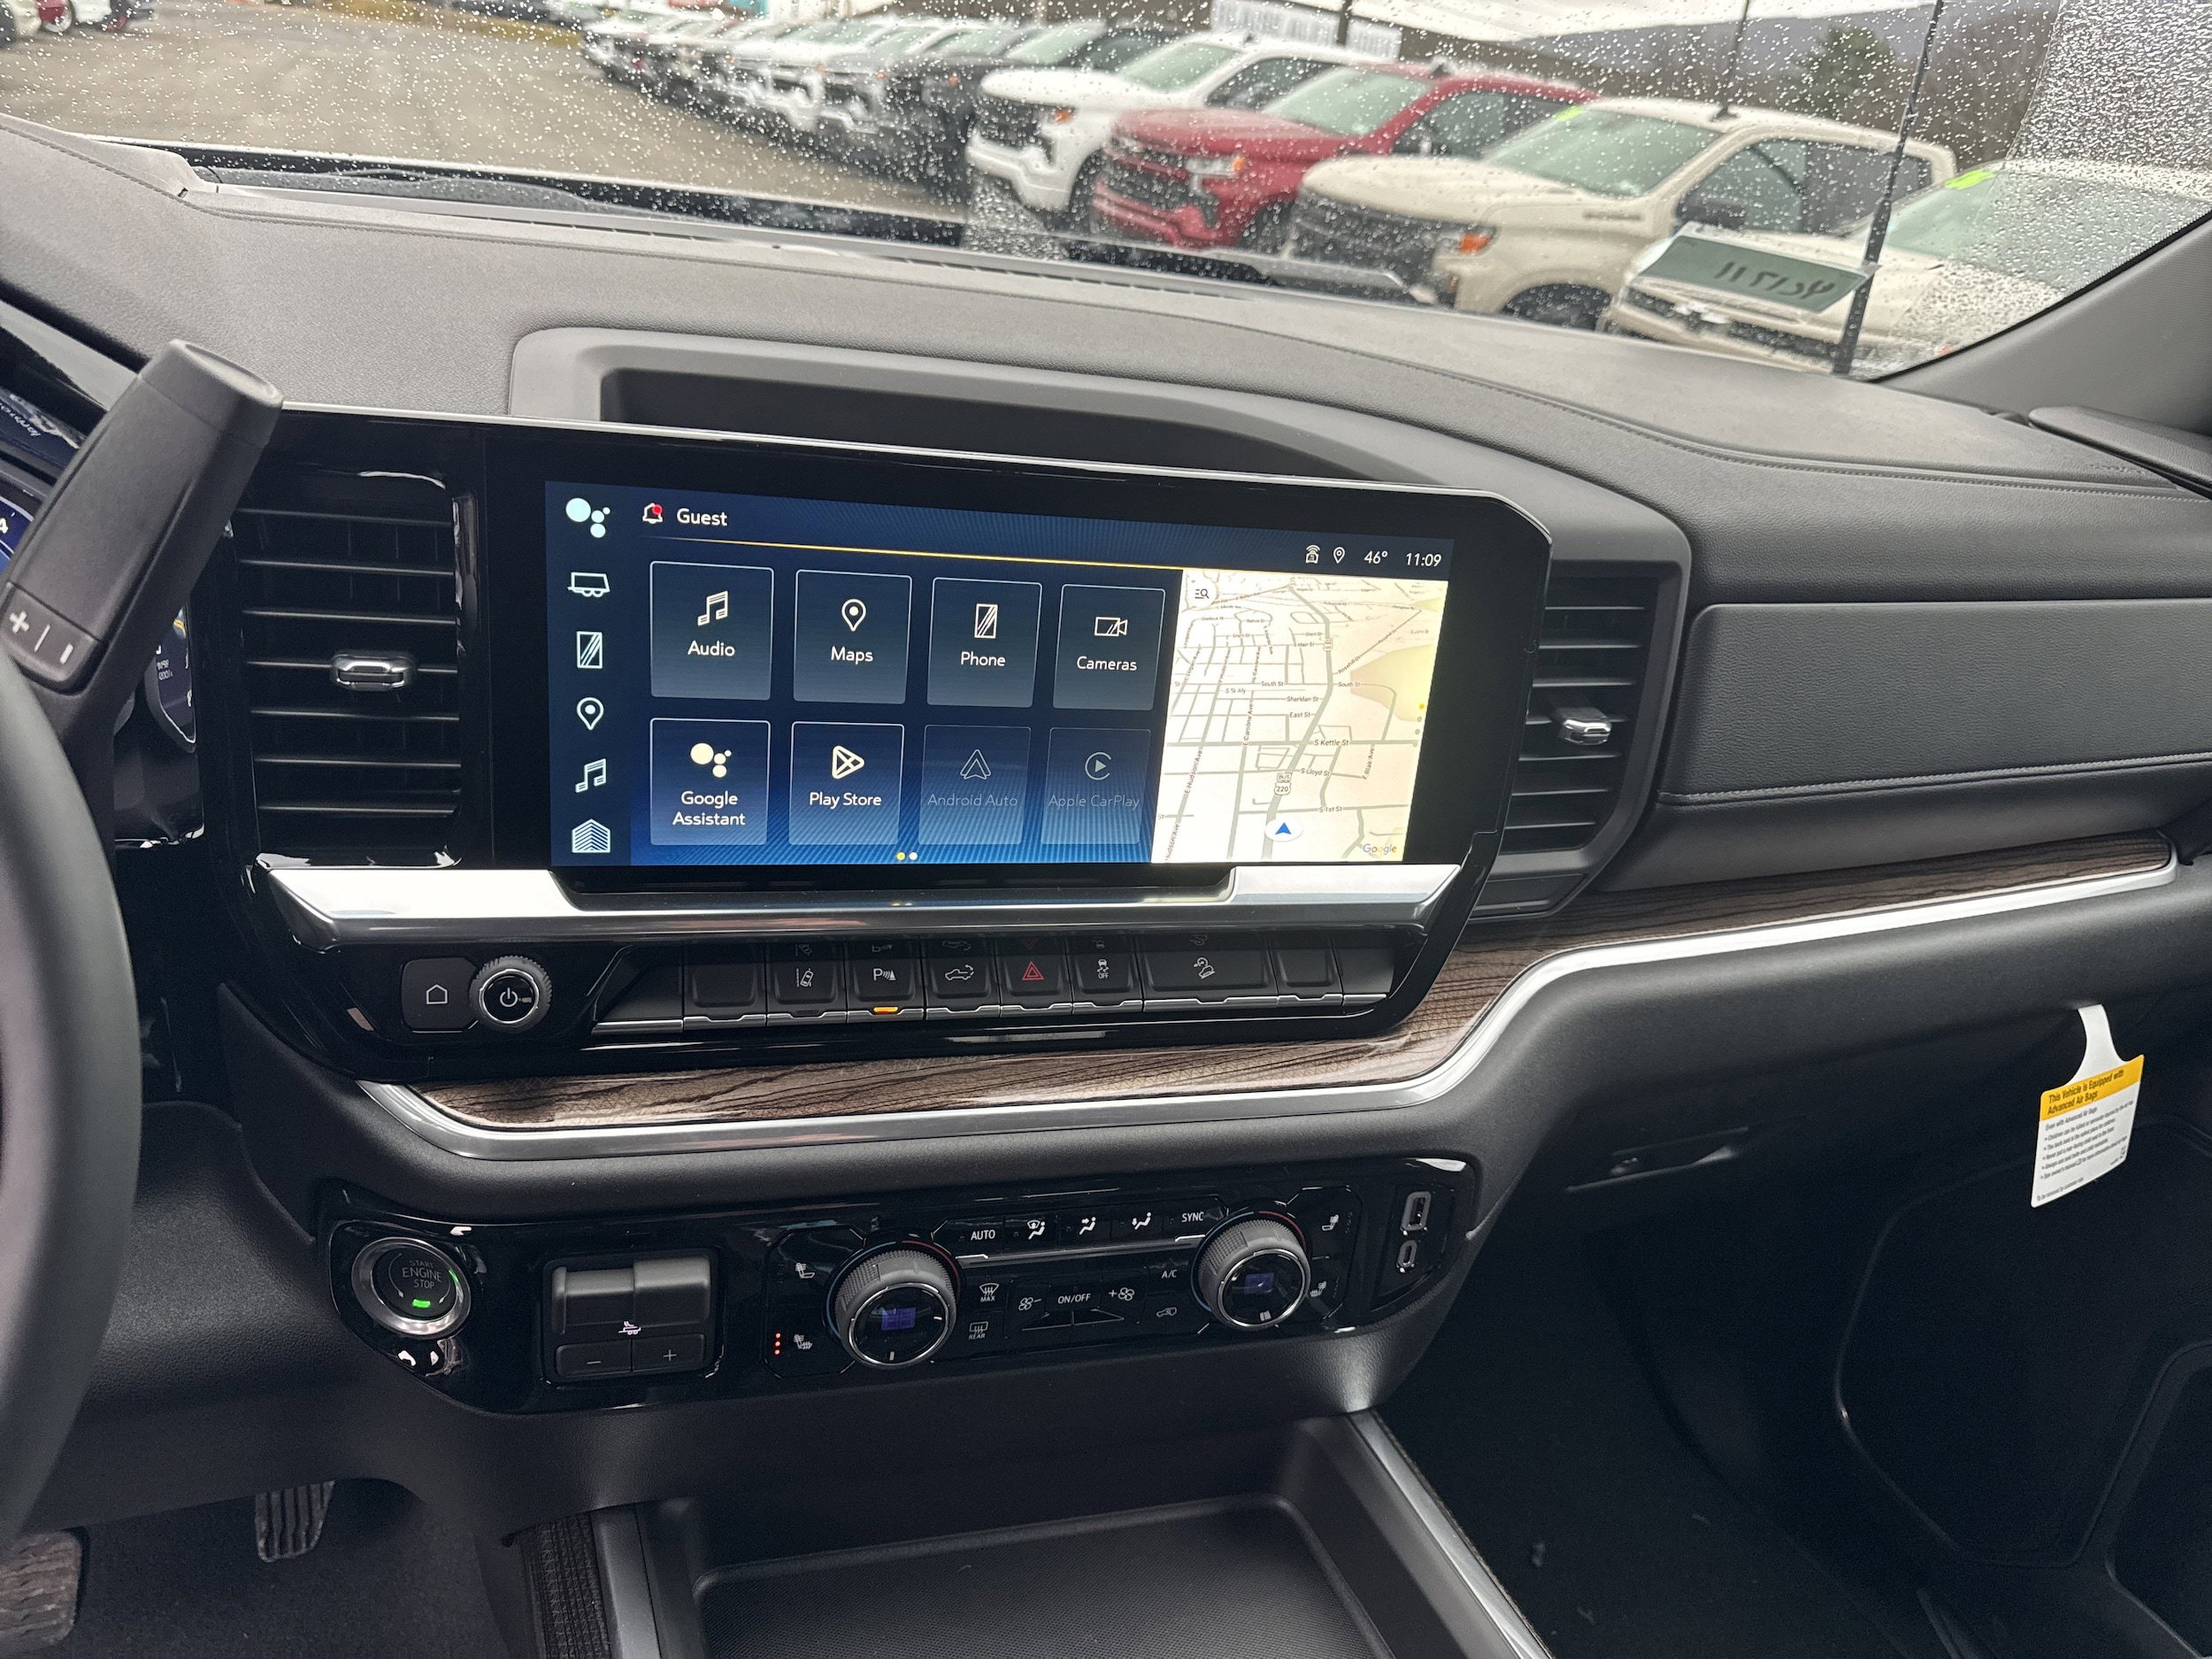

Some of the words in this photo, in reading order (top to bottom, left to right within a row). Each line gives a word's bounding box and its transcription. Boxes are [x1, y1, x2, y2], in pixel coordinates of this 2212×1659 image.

[677, 507, 728, 526] Guest
[1363, 550, 1388, 565] 46°
[1405, 552, 1442, 567] 11:09
[687, 641, 735, 657] Audio
[831, 647, 874, 664] Maps
[961, 651, 1006, 667] Phone
[1077, 657, 1138, 672] Cameras
[1243, 717, 1252, 741] Caroline
[1187, 762, 1199, 788] Hudson
[681, 791, 738, 815] Google
[809, 792, 840, 810] Play
[843, 793, 882, 807] Store
[927, 793, 981, 807] Android
[985, 794, 1018, 807] Auto
[1048, 794, 1087, 810] Apple
[1090, 794, 1141, 811] CarPlay
[672, 811, 746, 826] Assistant
[1171, 823, 1180, 836] Ave
[2048, 1093, 2061, 1103] This
[2062, 1086, 2082, 1099] Vehicle
[2083, 1082, 2088, 1092] is
[2088, 1073, 2113, 1089] Equipped
[2047, 1097, 2076, 1115] Advanced
[2085, 1090, 2098, 1102] Bags
[1181, 1211, 1204, 1222] SYNC
[971, 1229, 995, 1240] AUTO
[409, 1259, 434, 1268] START
[402, 1267, 442, 1283] ENGINE
[1161, 1269, 1178, 1279] A/C
[413, 1279, 434, 1289] STOP
[1057, 1293, 1091, 1304] ON/OFF
